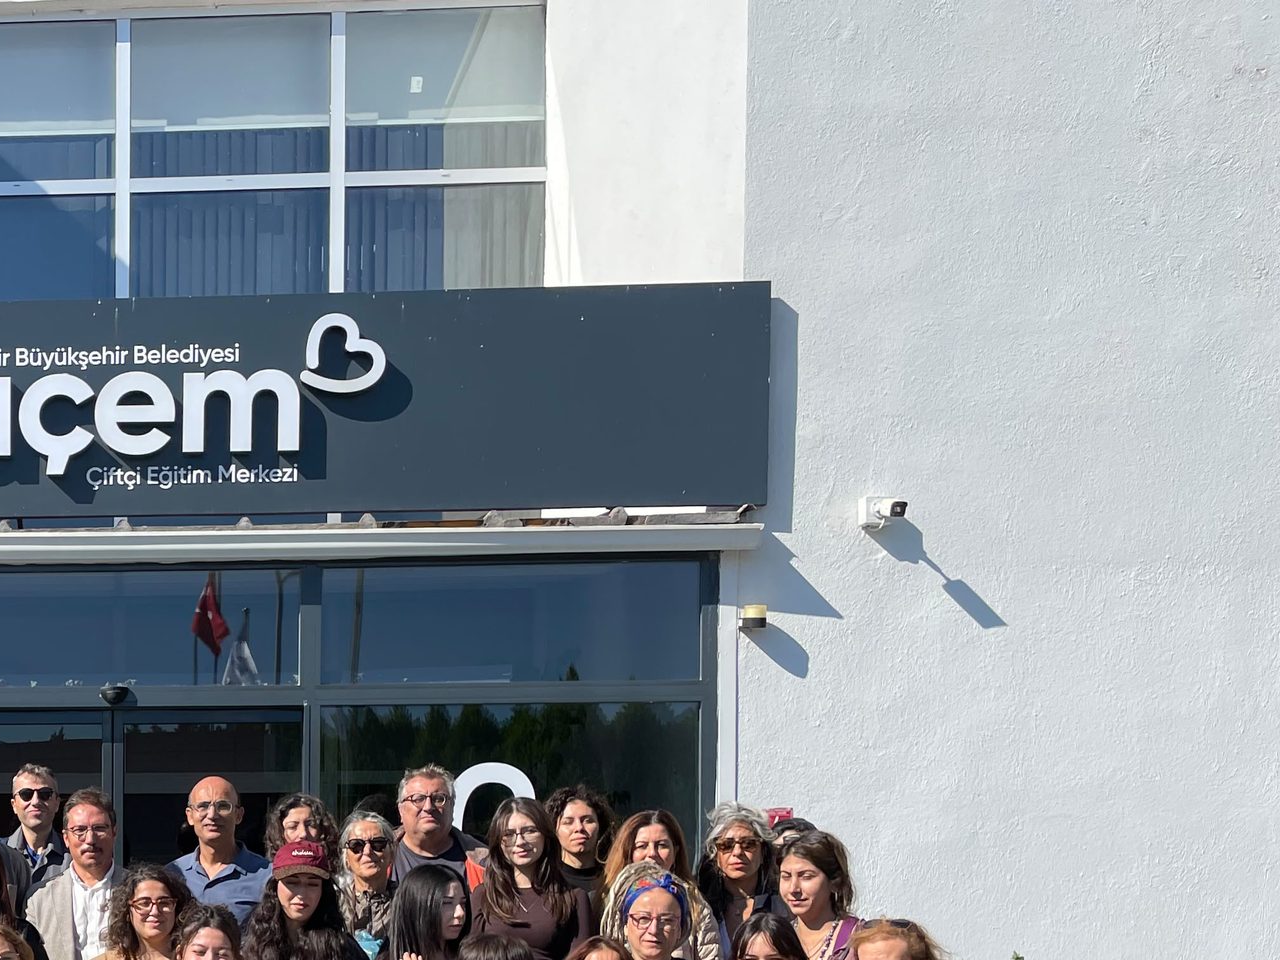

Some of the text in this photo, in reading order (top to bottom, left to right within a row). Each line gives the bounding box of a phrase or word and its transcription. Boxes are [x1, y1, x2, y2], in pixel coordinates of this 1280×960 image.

[15, 345, 128, 371] Büyükşehir
[133, 343, 240, 368] Belediyesi
[86, 463, 299, 490] Çiftçi Eğitim Merkezi
